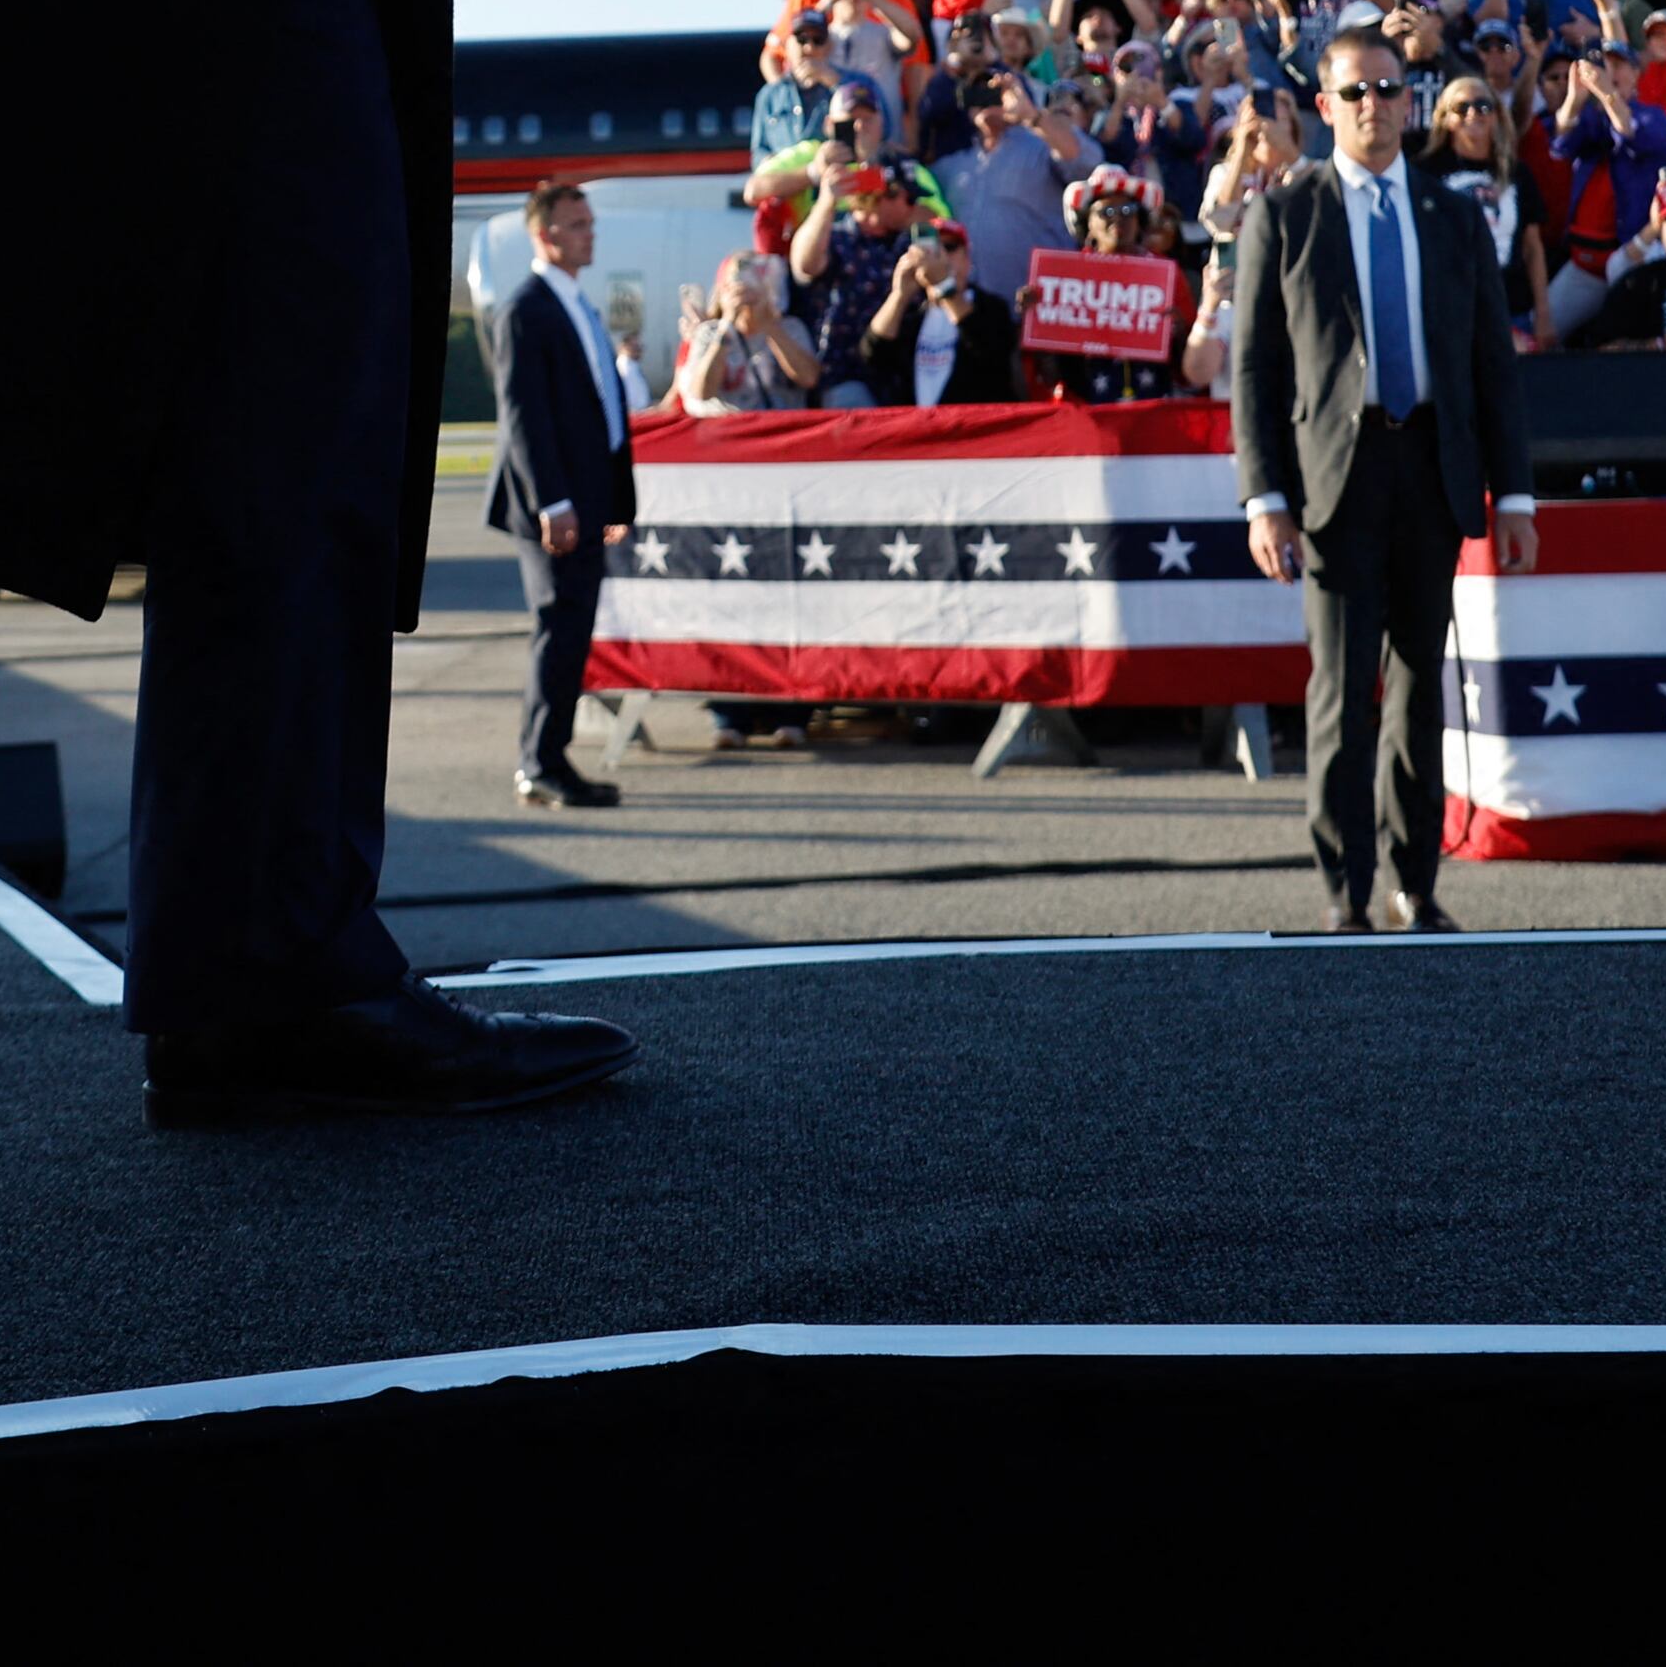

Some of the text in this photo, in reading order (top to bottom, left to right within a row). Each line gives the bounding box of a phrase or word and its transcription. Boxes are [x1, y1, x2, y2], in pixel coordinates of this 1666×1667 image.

[1037, 275, 1165, 311] TRUMP
[1036, 303, 1162, 334] WILL FIX IT
